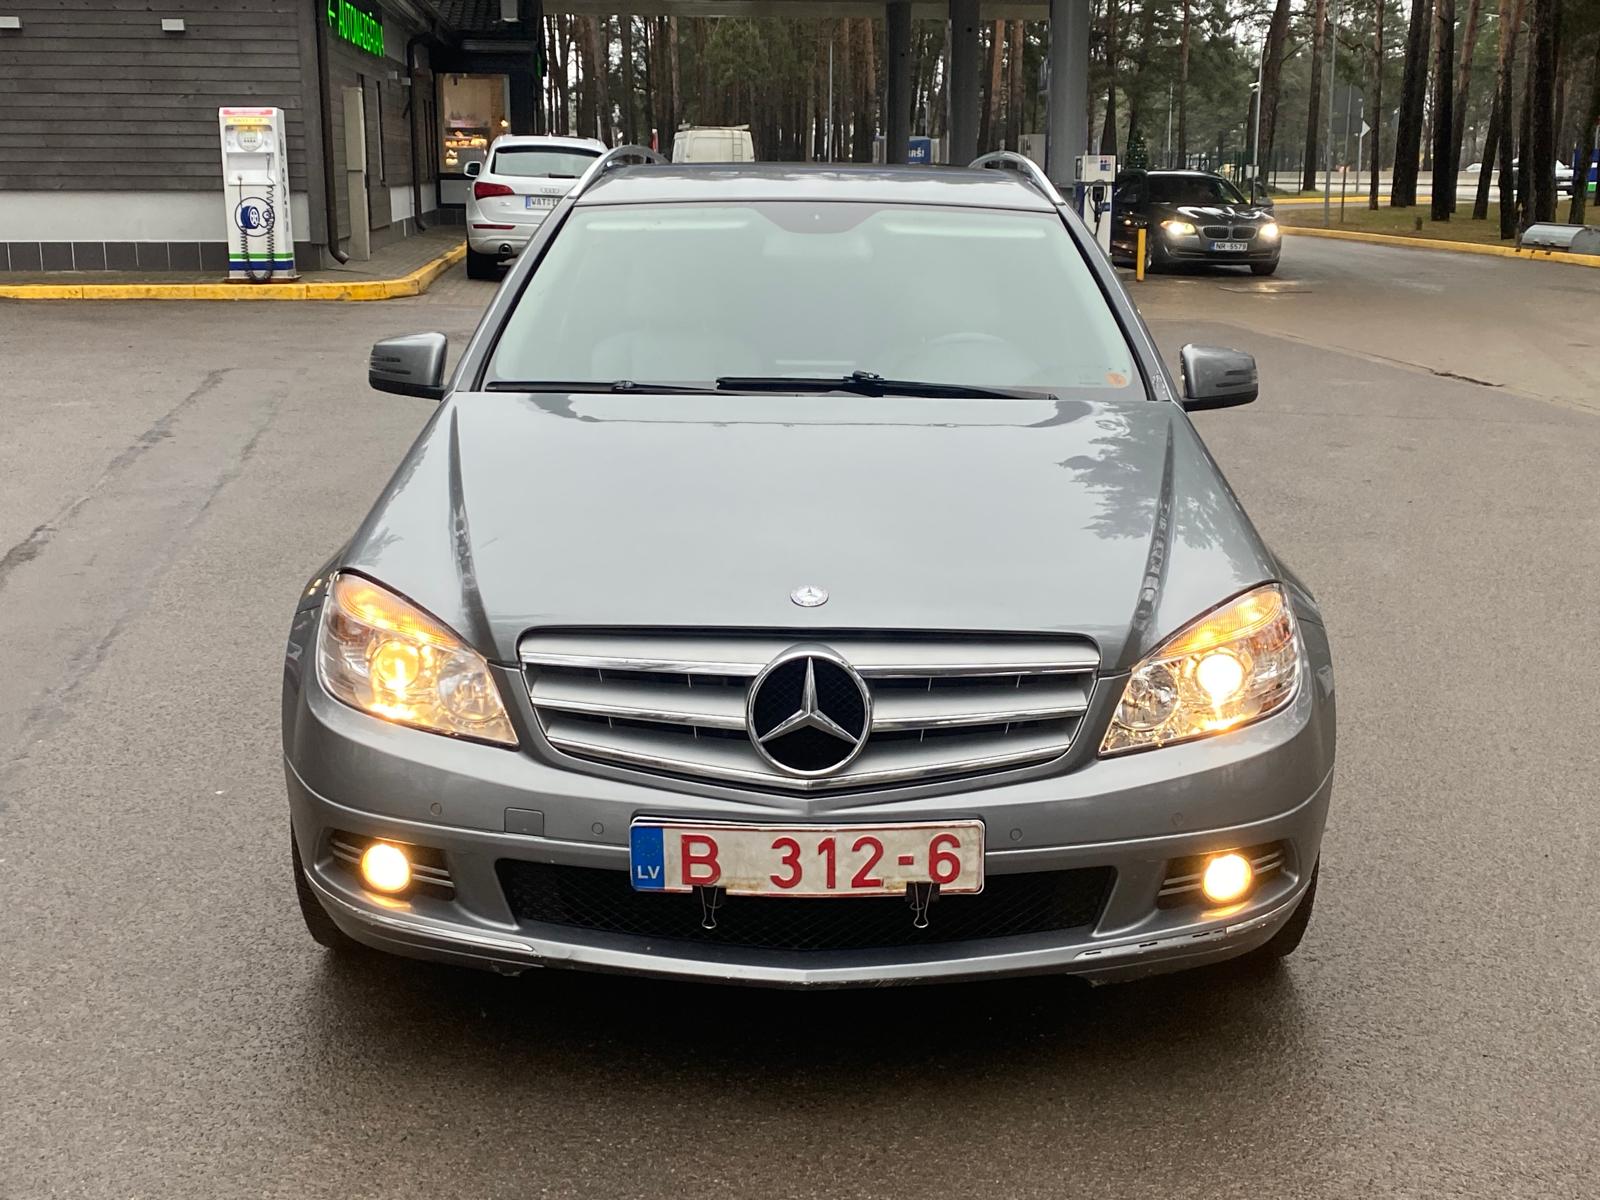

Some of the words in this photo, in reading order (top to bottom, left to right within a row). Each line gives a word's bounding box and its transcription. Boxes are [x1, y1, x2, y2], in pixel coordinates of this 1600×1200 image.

[637, 865, 660, 879] LV
[681, 834, 722, 886] B
[769, 833, 962, 889] 312-6
